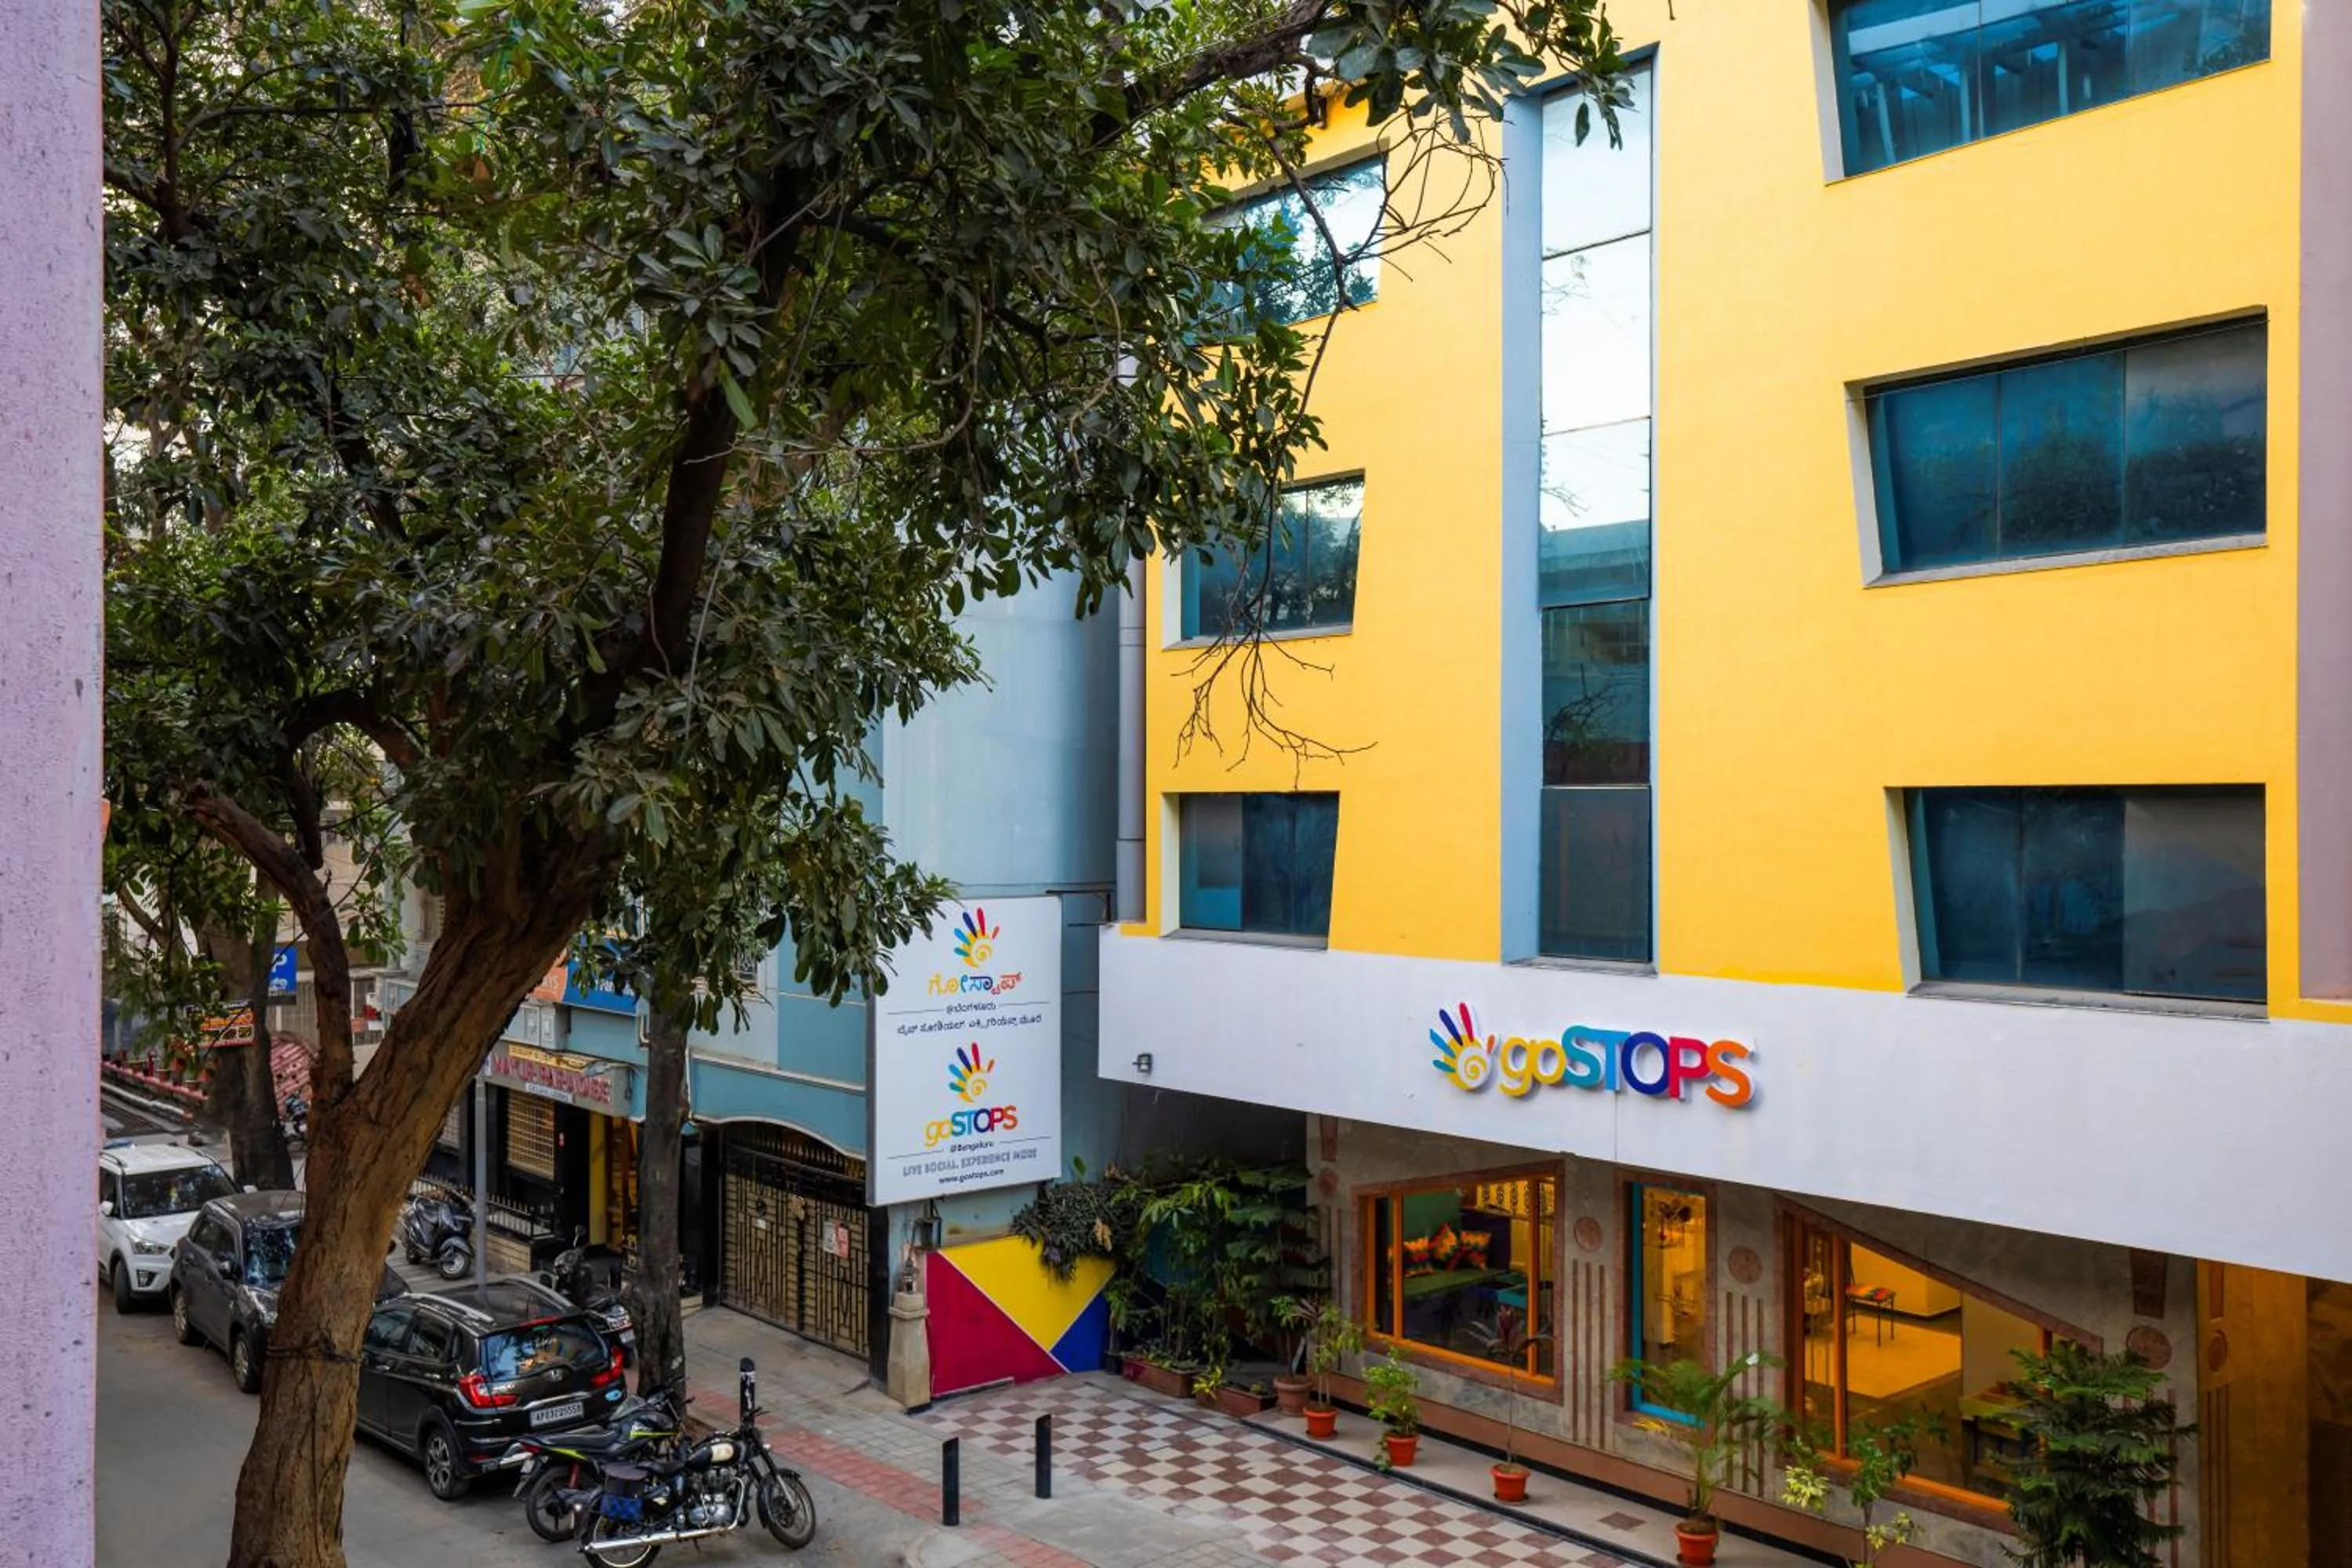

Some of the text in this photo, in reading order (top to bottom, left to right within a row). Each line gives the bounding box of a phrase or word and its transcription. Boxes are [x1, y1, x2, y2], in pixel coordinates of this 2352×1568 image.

[1499, 1025, 1755, 1109] goSTOPS
[924, 1105, 1018, 1148] goSTOPS
[949, 1142, 995, 1153] @Bengaluru
[903, 1163, 922, 1177] LIVE
[960, 1151, 1011, 1169] EXPERIENCE
[938, 1168, 1004, 1185] www.gostops.com
